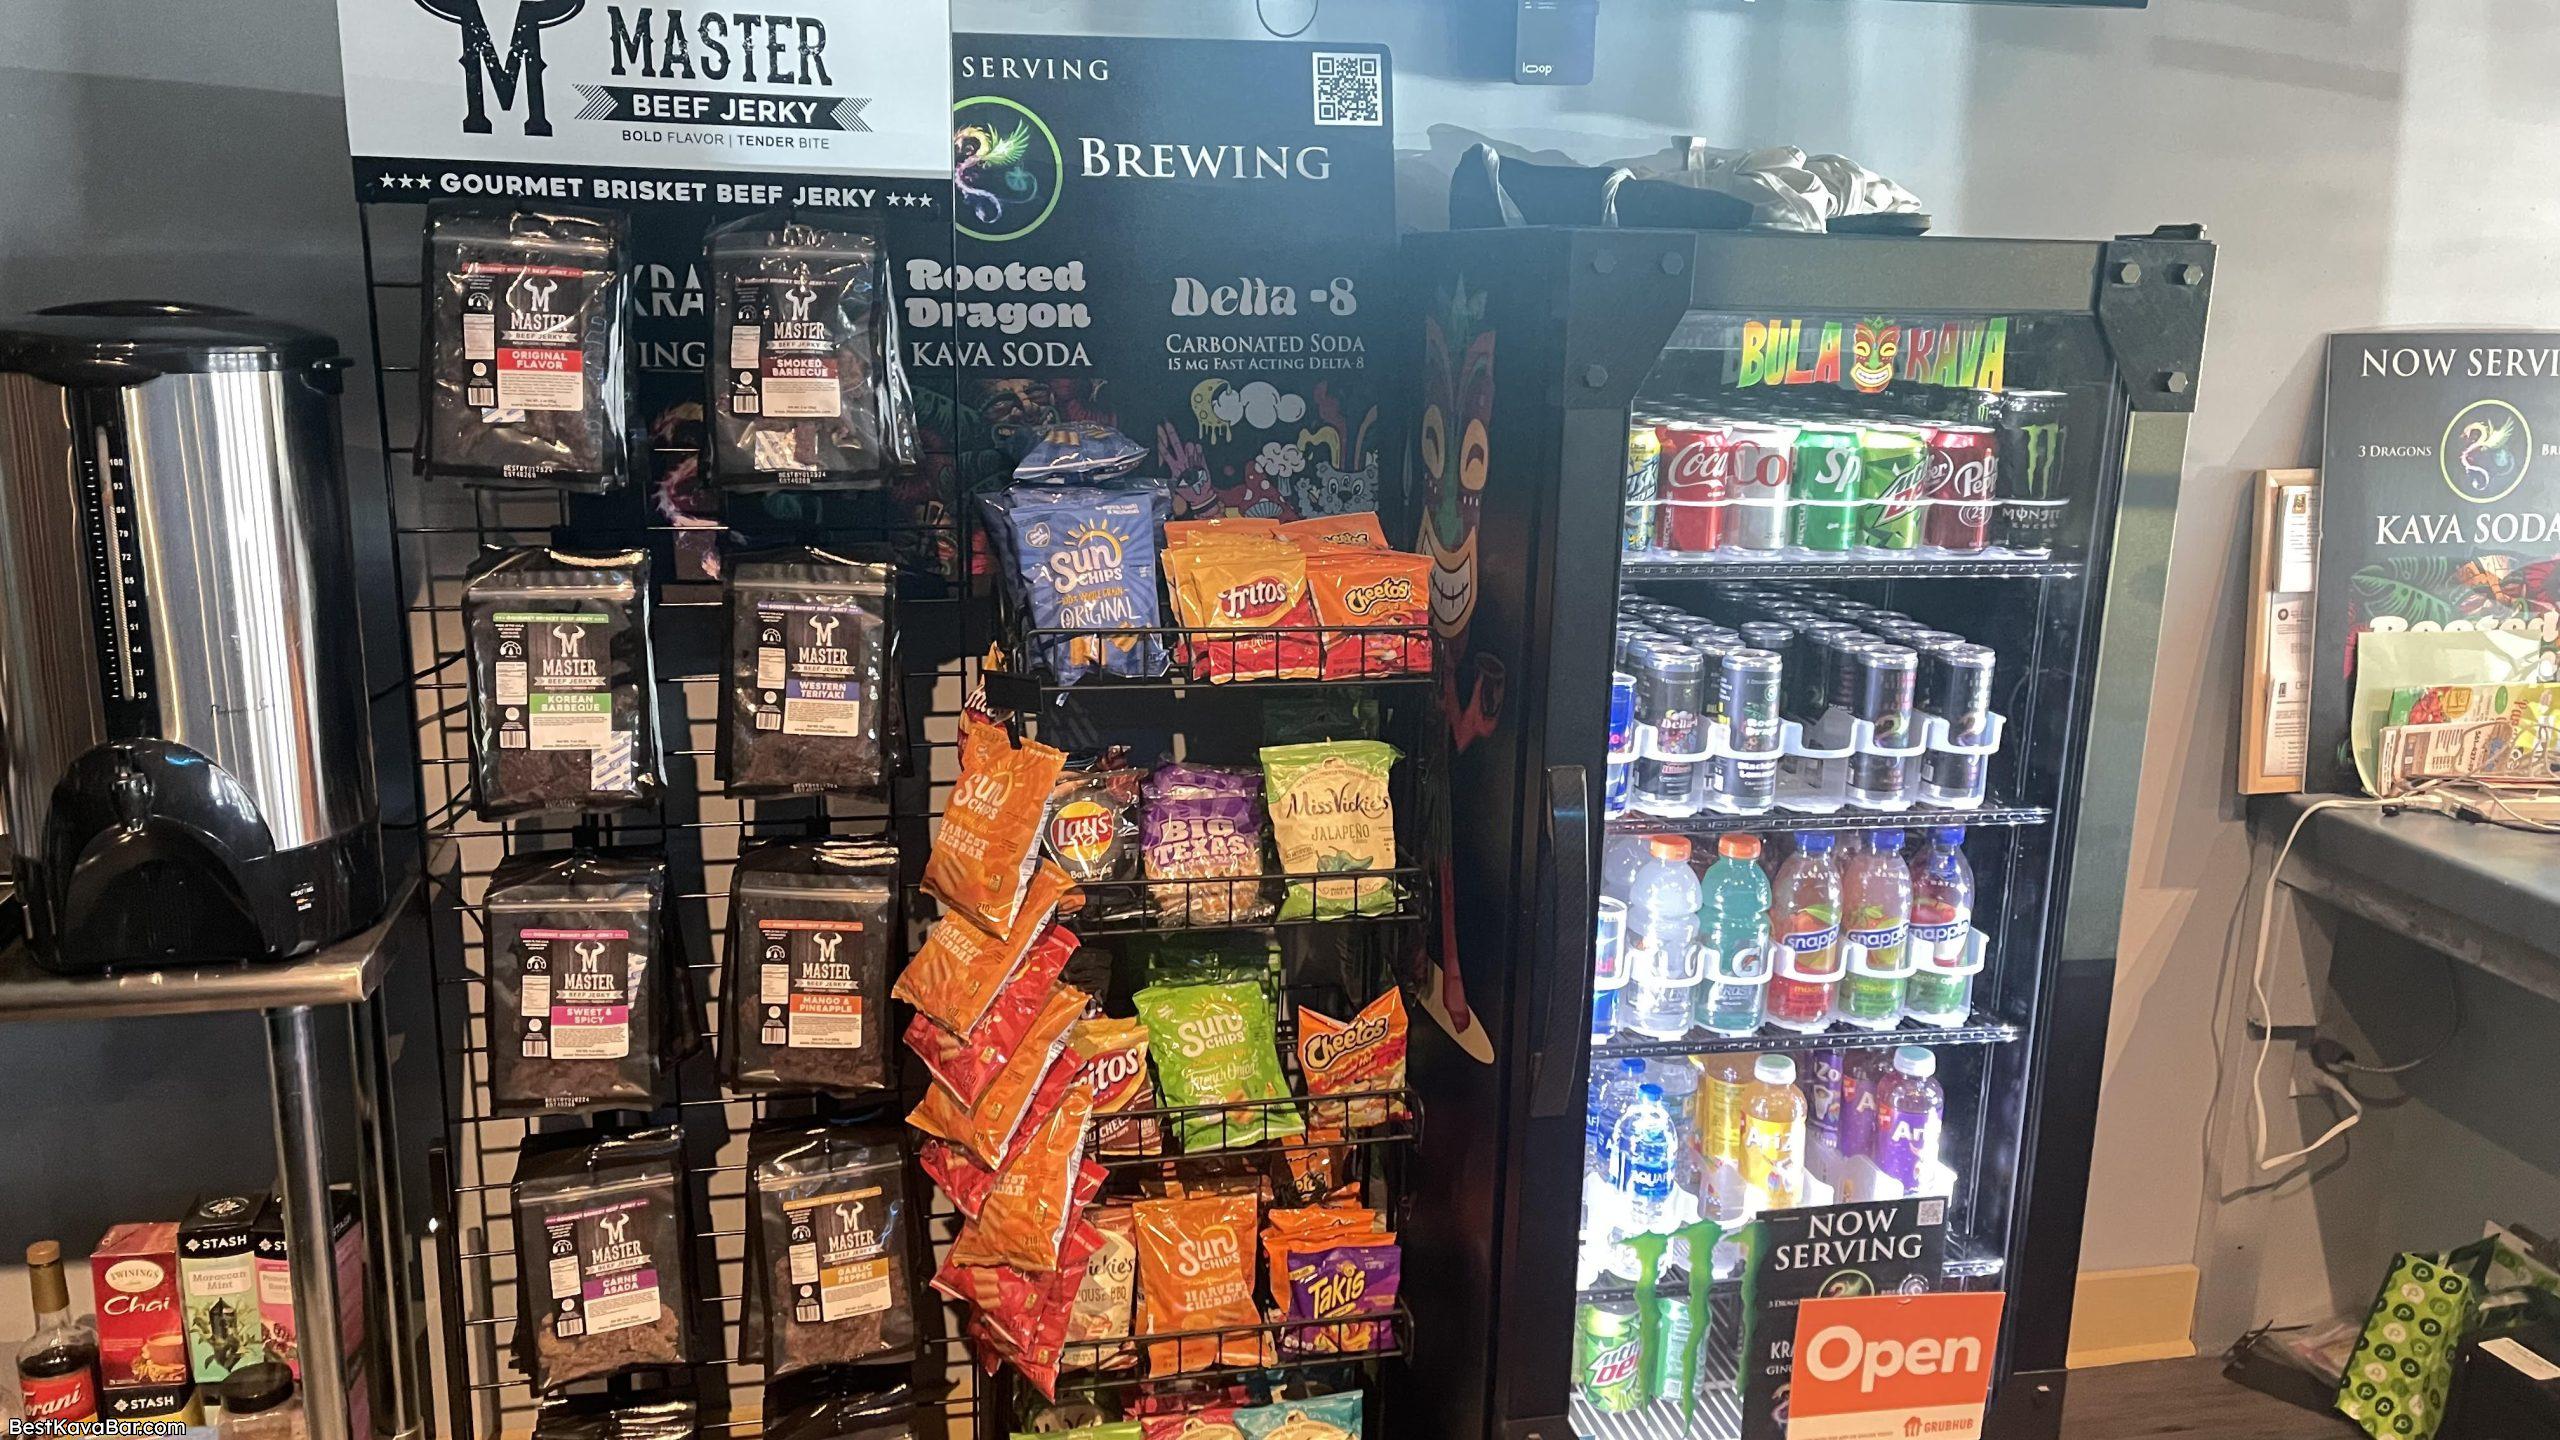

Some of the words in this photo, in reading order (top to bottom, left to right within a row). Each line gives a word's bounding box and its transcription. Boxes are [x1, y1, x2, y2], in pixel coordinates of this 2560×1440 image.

[608, 6, 833, 86] MASTER
[962, 57, 1109, 80] SERVING
[1522, 62, 1552, 76] loop
[633, 94, 711, 119] BEEF
[720, 97, 819, 124] JERKY
[622, 130, 662, 142] BOLD
[667, 132, 724, 145] FLAVOR
[737, 135, 794, 148] TENDER
[799, 138, 830, 149] BITE
[1079, 137, 1331, 180] BREWING
[440, 172, 582, 198] GOURMET
[594, 179, 706, 202] BRISKET
[717, 184, 783, 204] BEEF
[793, 186, 876, 208] JERKY
[906, 259, 1086, 292] Rooted
[1171, 277, 1296, 316] Delta
[905, 298, 1091, 334] Dragon
[774, 322, 825, 340] MASTER
[1166, 334, 1303, 353] CARBONATED
[1310, 334, 1364, 353] SODA
[512, 351, 568, 361] ORIGINAL
[777, 359, 822, 368] SMOKED
[912, 342, 990, 367] KAVA
[1001, 342, 1092, 367] SODA
[1168, 357, 1181, 370] 15
[1185, 358, 1209, 370] MG
[1214, 357, 1245, 370] FAST
[1250, 357, 1303, 370] ACTING
[1309, 357, 1364, 370] DELTA-8
[1736, 319, 1843, 389] BULA
[1905, 317, 2008, 392] KAVA
[2360, 347, 2457, 378] NOW
[517, 360, 563, 369] FLAVOR
[772, 367, 828, 377] BARBECUE
[2358, 446, 2366, 458] 3
[2369, 445, 2432, 458] DRAGONS
[1971, 506, 1985, 519] 23
[2375, 513, 2466, 545] KAVA
[2473, 512, 2560, 544] SODA
[1050, 544, 1122, 594] Sun
[1078, 568, 1123, 586] CHIPS
[1345, 578, 1411, 614] Cheetos
[1060, 596, 1142, 629] ORIGINAL
[799, 647, 848, 664] MASTER
[543, 659, 598, 676] MASTER
[800, 682, 846, 691] WESTERN
[801, 690, 845, 699] TERIYAKI
[541, 703, 600, 712] BARBEQUE
[547, 695, 594, 704] KOREAN
[1286, 792, 1332, 818] Miss
[1327, 782, 1389, 819] Vickie's
[968, 800, 999, 821] CHIPS
[1161, 819, 1235, 843] BIG
[1311, 823, 1370, 841] JALAPEÑO
[938, 832, 986, 862] HEDDAR
[1154, 836, 1249, 866] TEXAS
[803, 963, 851, 980] MASTER
[564, 973, 615, 990] MASTER
[800, 1004, 853, 1013] PINEAPPLE
[803, 996, 840, 1004] MANGO
[567, 1008, 602, 1016] SWEET
[574, 1016, 604, 1024] SPICY
[1178, 1014, 1244, 1058] Sun
[1206, 1030, 1246, 1050] CHIPS
[1305, 1017, 1388, 1070] Cheetos
[1071, 1048, 1140, 1097] itos
[1808, 1207, 1899, 1239] NOW
[202, 1234, 248, 1250] STASH
[828, 1229, 876, 1253] MASTER
[591, 1240, 643, 1265] MASTER
[1178, 1235, 1239, 1277] Sun
[1200, 1250, 1242, 1271] CHIPS
[1774, 1233, 1923, 1272] SERVING
[109, 1267, 161, 1283] TWININGS
[192, 1270, 248, 1283] Moroccan
[837, 1263, 873, 1276] GARLIC
[838, 1272, 874, 1284] PEPPER
[1088, 1254, 1134, 1283] ickie's
[207, 1279, 234, 1291] Mint
[603, 1273, 638, 1288] CARNE
[603, 1283, 639, 1296] ASADA
[1184, 1281, 1250, 1303] HARVEST
[1308, 1269, 1367, 1320] Takis
[104, 1295, 171, 1316] Chai
[1806, 1325, 1982, 1394] Open
[130, 1394, 174, 1411] STASH
[1924, 1418, 1974, 1434] GRUBHUB
